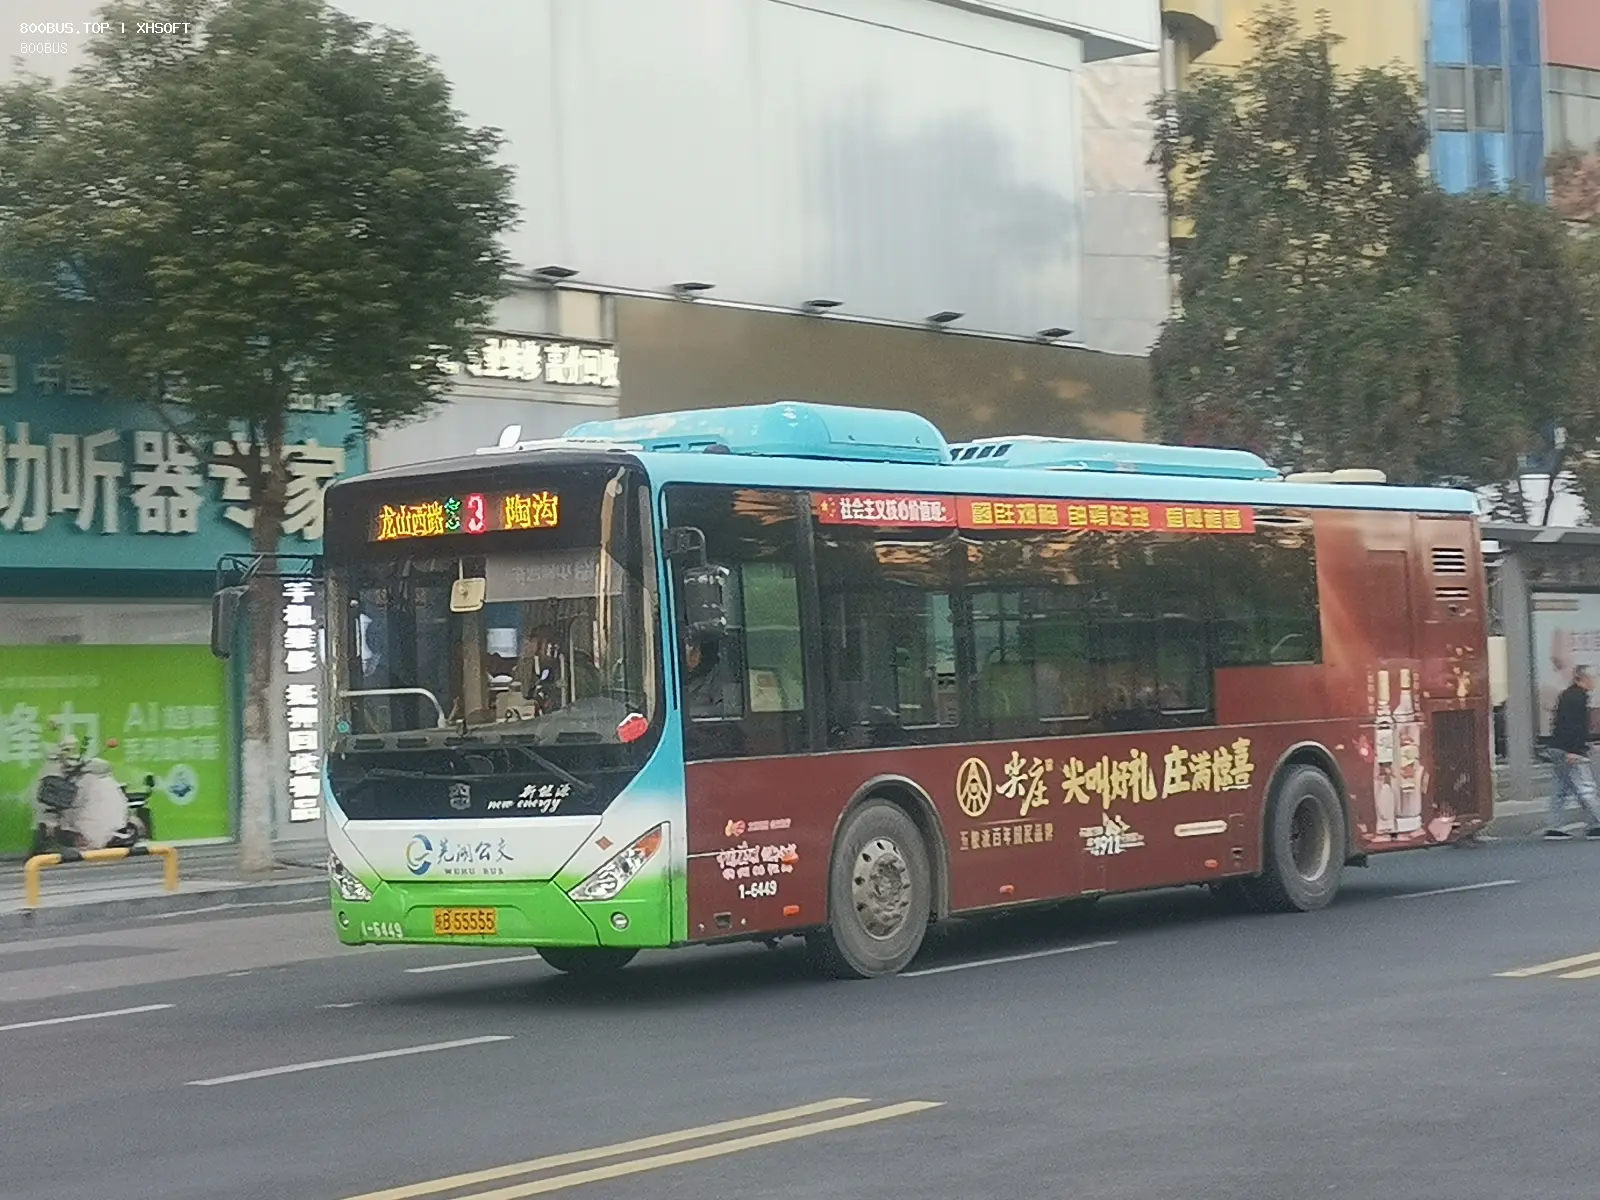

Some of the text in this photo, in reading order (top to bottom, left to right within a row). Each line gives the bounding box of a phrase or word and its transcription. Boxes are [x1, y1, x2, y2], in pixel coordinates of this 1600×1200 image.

[376, 490, 559, 542] 龙山西路 3 陶沟
[1061, 748, 1158, 810] 尖叫好礼
[1161, 737, 1255, 799] 庄满惊喜
[516, 798, 562, 813] energy
[437, 837, 515, 865] 芜湖公交
[444, 867, 504, 875] WUHU BUS
[738, 879, 778, 899] 1-6449
